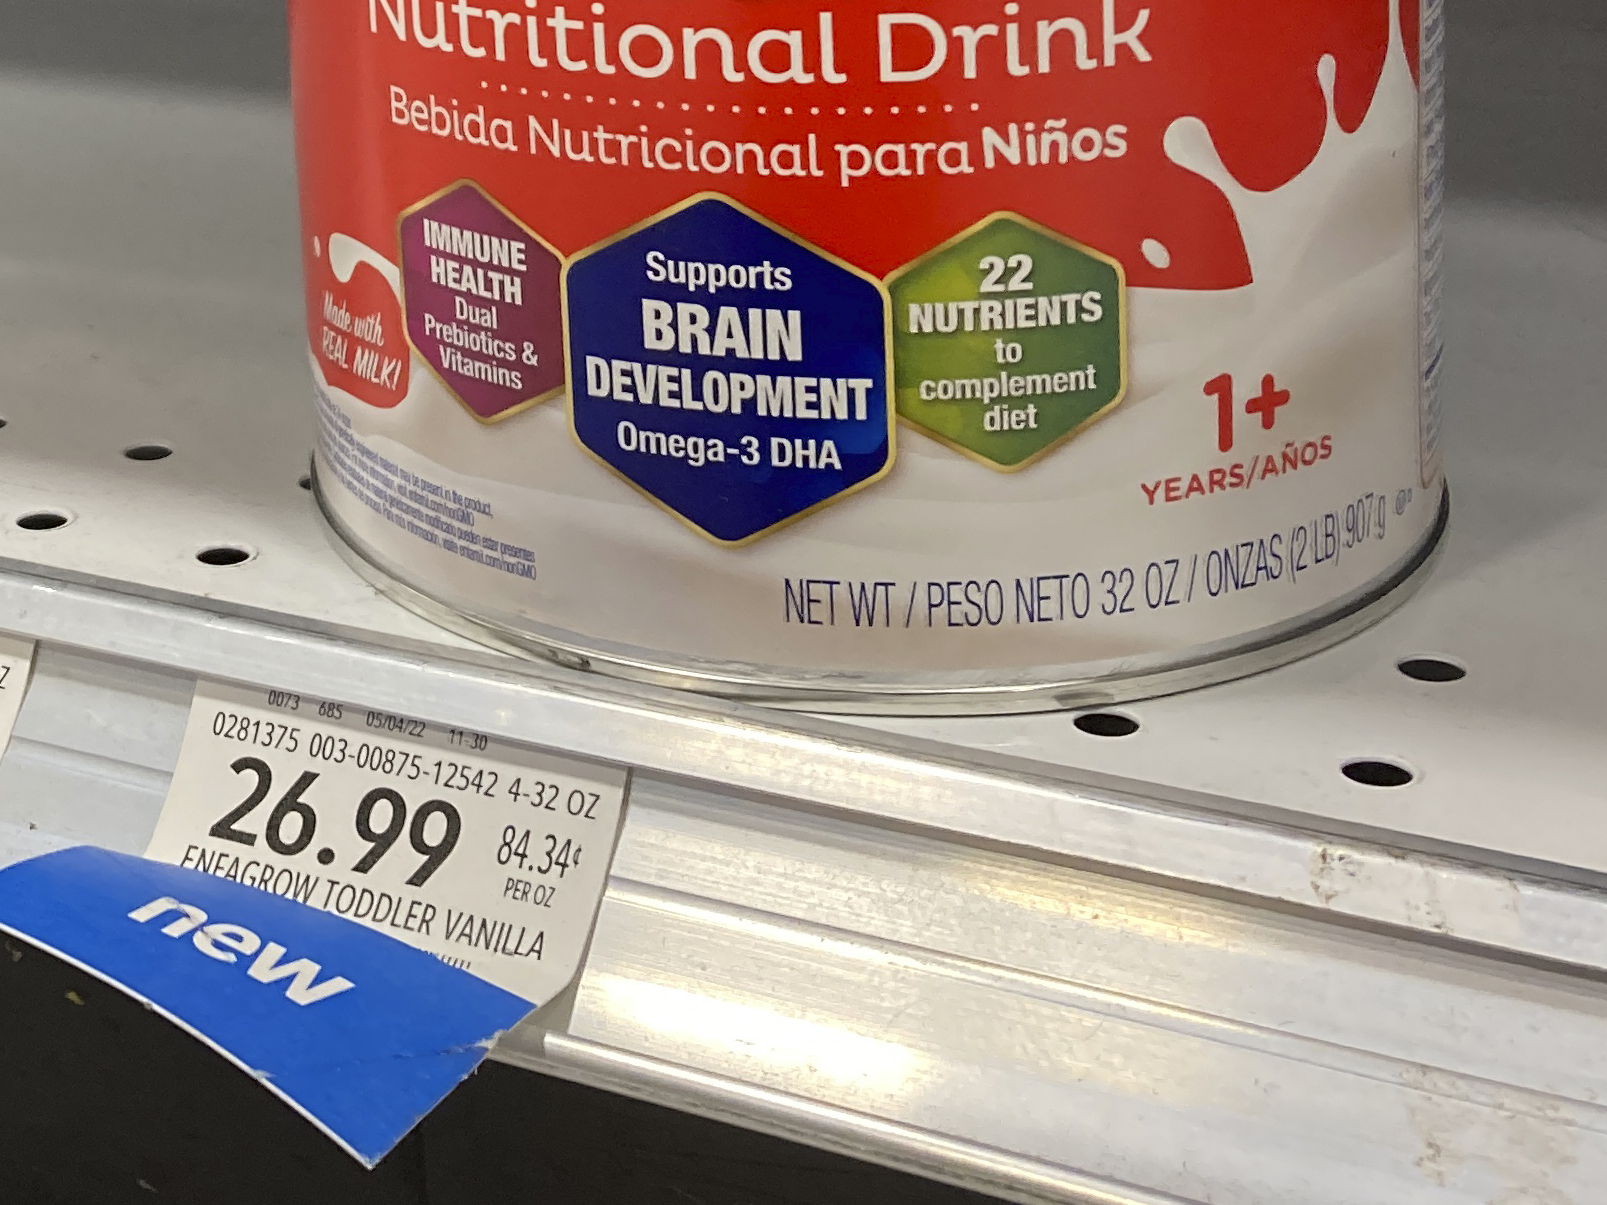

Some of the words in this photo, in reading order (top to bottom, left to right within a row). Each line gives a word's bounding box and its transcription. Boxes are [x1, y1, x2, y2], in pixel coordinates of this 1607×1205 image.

[388, 84, 518, 153] Bebida
[526, 114, 824, 177] Nutricional
[835, 137, 974, 187] para
[981, 120, 1128, 170] Niños
[422, 218, 527, 272] IMMUNE
[645, 250, 793, 294] Supports
[979, 253, 1034, 293] 22
[429, 255, 523, 306] HEALTH
[323, 290, 352, 333] Made
[354, 312, 385, 347] with
[424, 312, 517, 362] Prebiotics
[522, 341, 539, 367] &
[454, 295, 498, 330] Dual
[642, 298, 803, 362] BRAIN
[908, 290, 1103, 334] NUTRIENTS
[322, 325, 349, 369] REAL
[353, 345, 402, 392] MILK!
[439, 344, 523, 390] Vitamins
[994, 337, 1023, 364] to
[585, 355, 874, 421] DEVELOPMENT
[919, 364, 1097, 403] complement
[983, 403, 1038, 432] diet
[1203, 372, 1291, 453] 1+
[617, 420, 761, 467] Omega-3
[770, 437, 842, 470] DHA
[1140, 434, 1334, 506] YEARS/AÑOS
[782, 577, 840, 628] NET
[848, 581, 896, 629] WT
[904, 581, 918, 629] /
[926, 577, 1004, 628] PESO
[1014, 571, 1091, 626] NETO
[1100, 566, 1136, 617] 32
[1145, 558, 1180, 611] OZ
[1185, 553, 1198, 605] /
[1205, 533, 1284, 599] ONZAS
[1289, 525, 1308, 583] (2
[1313, 510, 1340, 567] LB)
[1345, 492, 1374, 549] 907
[268, 690, 301, 710] 0073
[318, 701, 343, 720] 685
[366, 711, 427, 738] 05/04/22
[449, 729, 488, 751] 11-30
[212, 711, 301, 753] 0281375
[308, 732, 499, 798] 003-00875-12542
[507, 776, 559, 811] 4-32
[567, 788, 601, 821] OZ
[209, 756, 462, 888] 26.99
[180, 845, 319, 905] ENFAGROW
[322, 879, 437, 936] TODDLER
[445, 908, 546, 961] VANILLA
[503, 876, 535, 903] PER
[533, 882, 557, 908] OZ
[131, 894, 356, 1007] new
